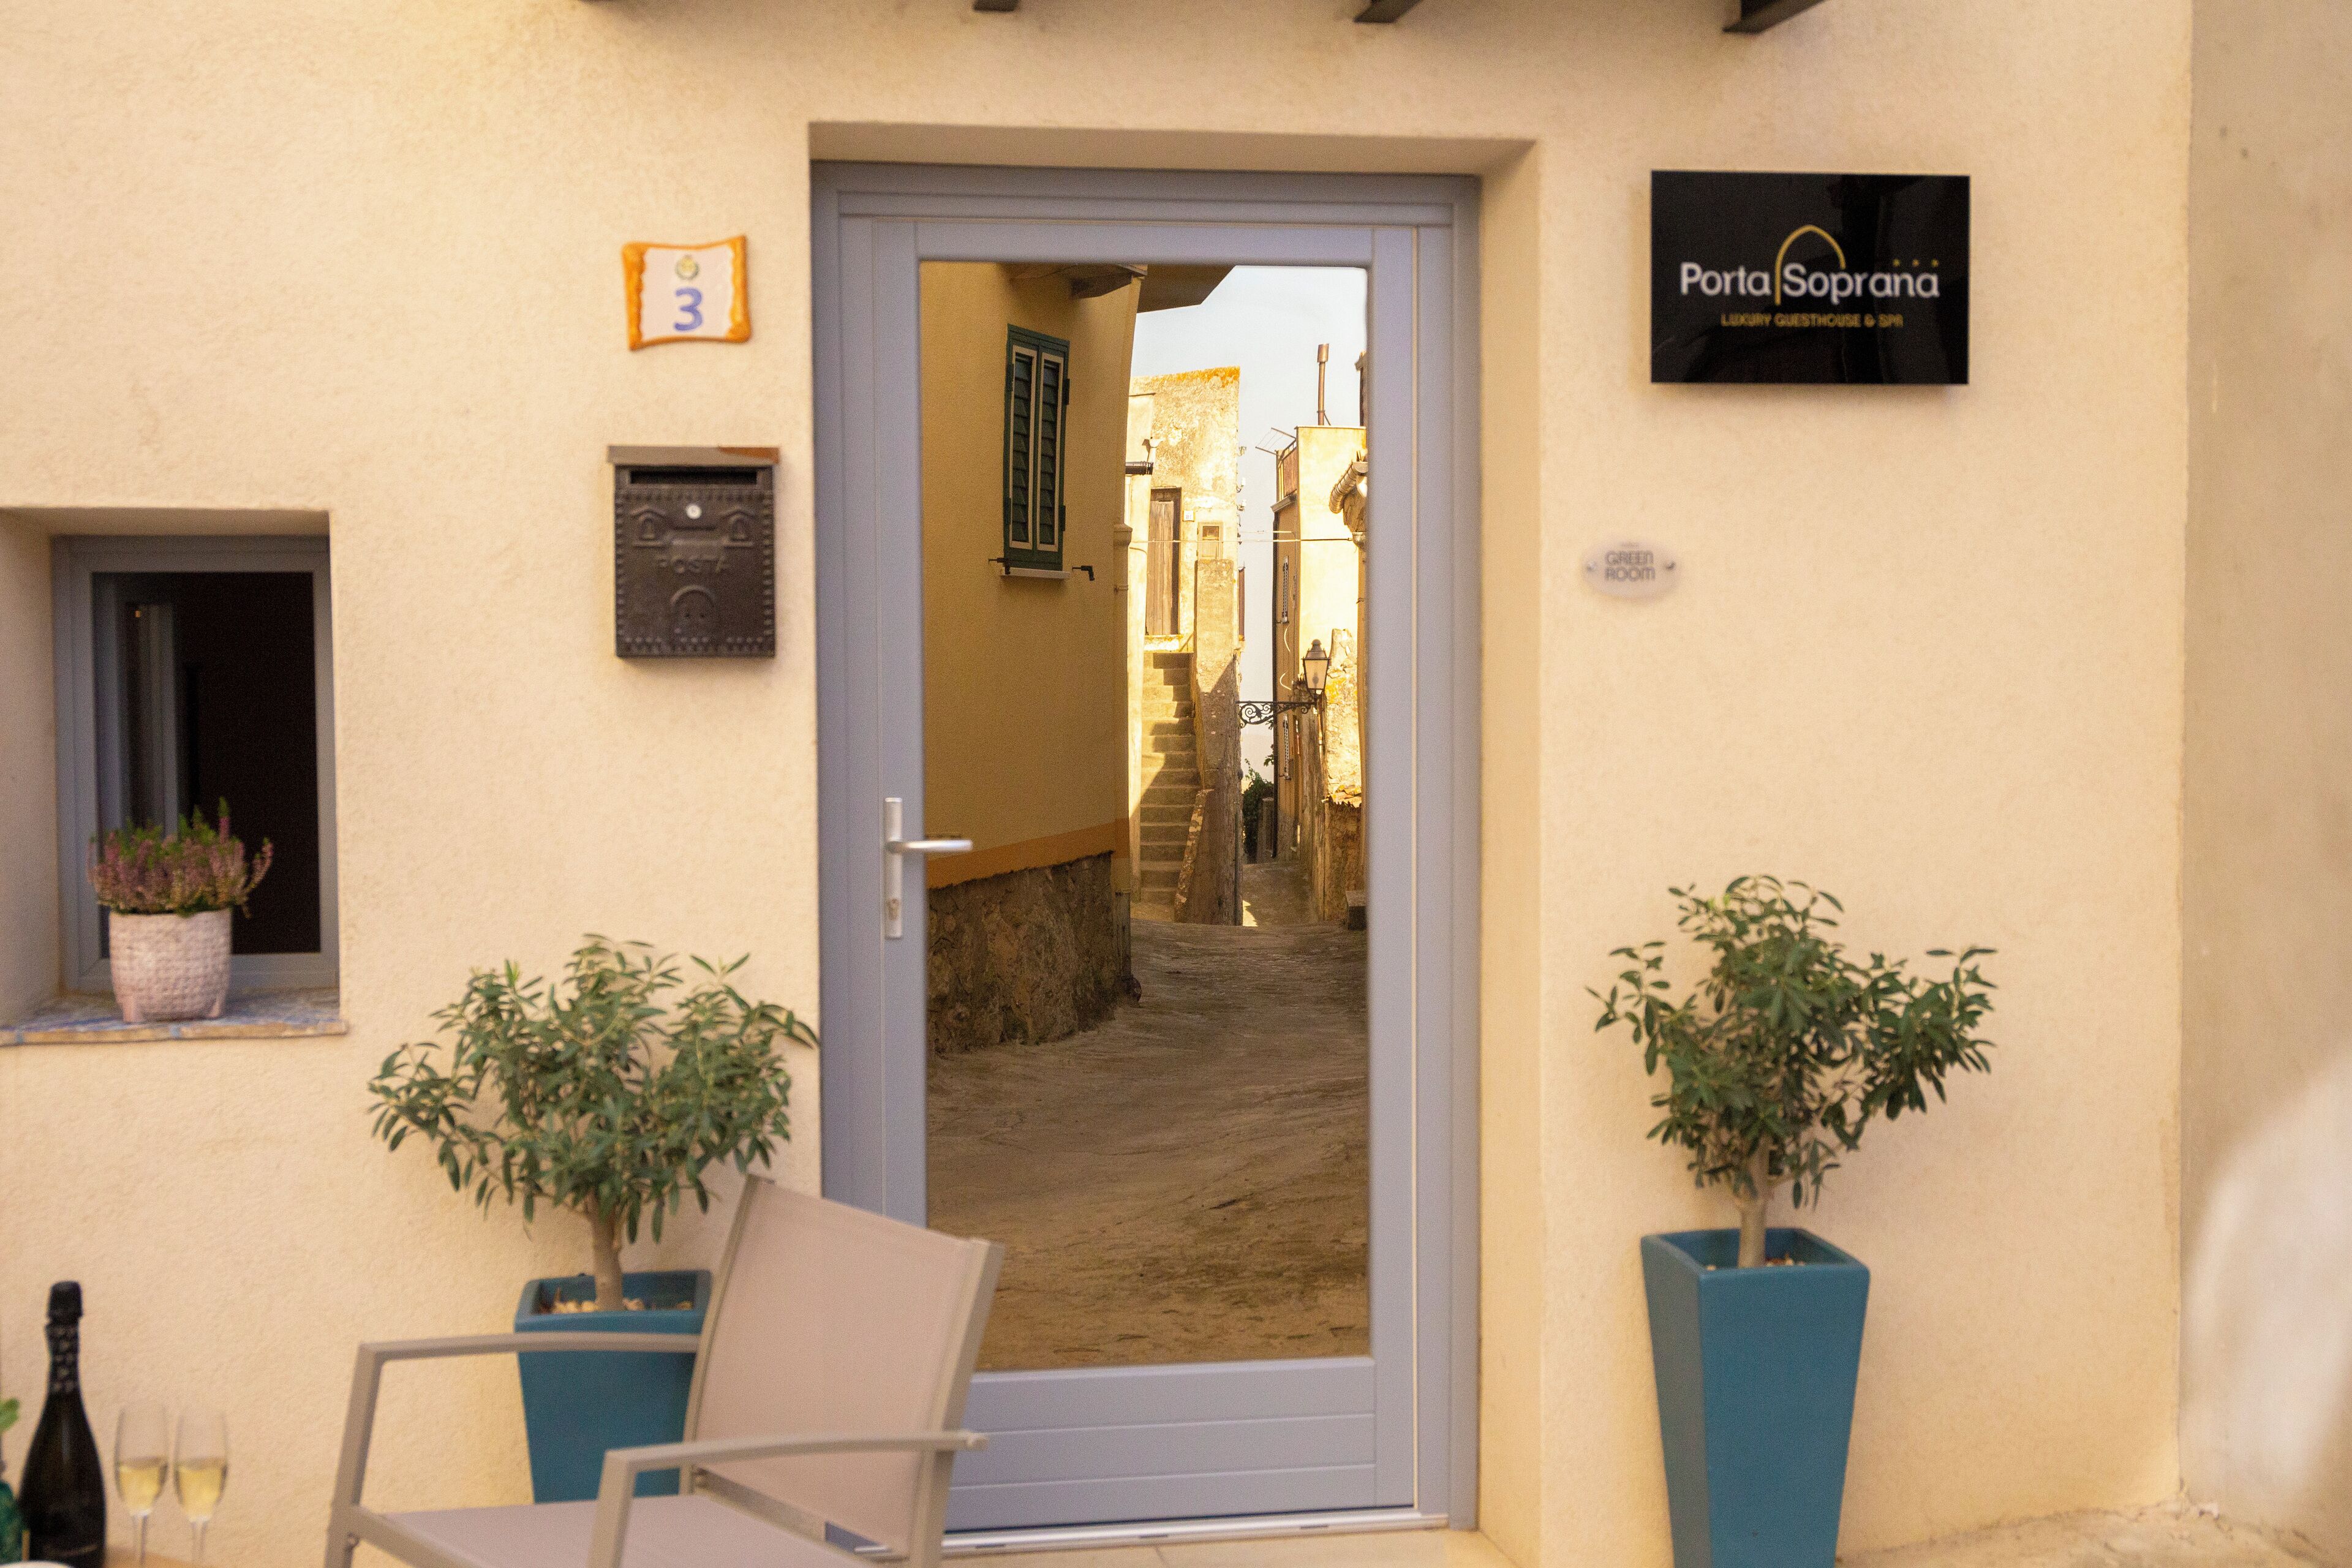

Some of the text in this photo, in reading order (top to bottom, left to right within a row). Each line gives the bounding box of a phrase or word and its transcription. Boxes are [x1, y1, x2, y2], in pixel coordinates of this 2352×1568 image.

[1680, 262, 1940, 305] Porta Soprana
[674, 287, 703, 332] 3
[1721, 313, 1904, 328] LUXURY GUESTHOUSE & SPA
